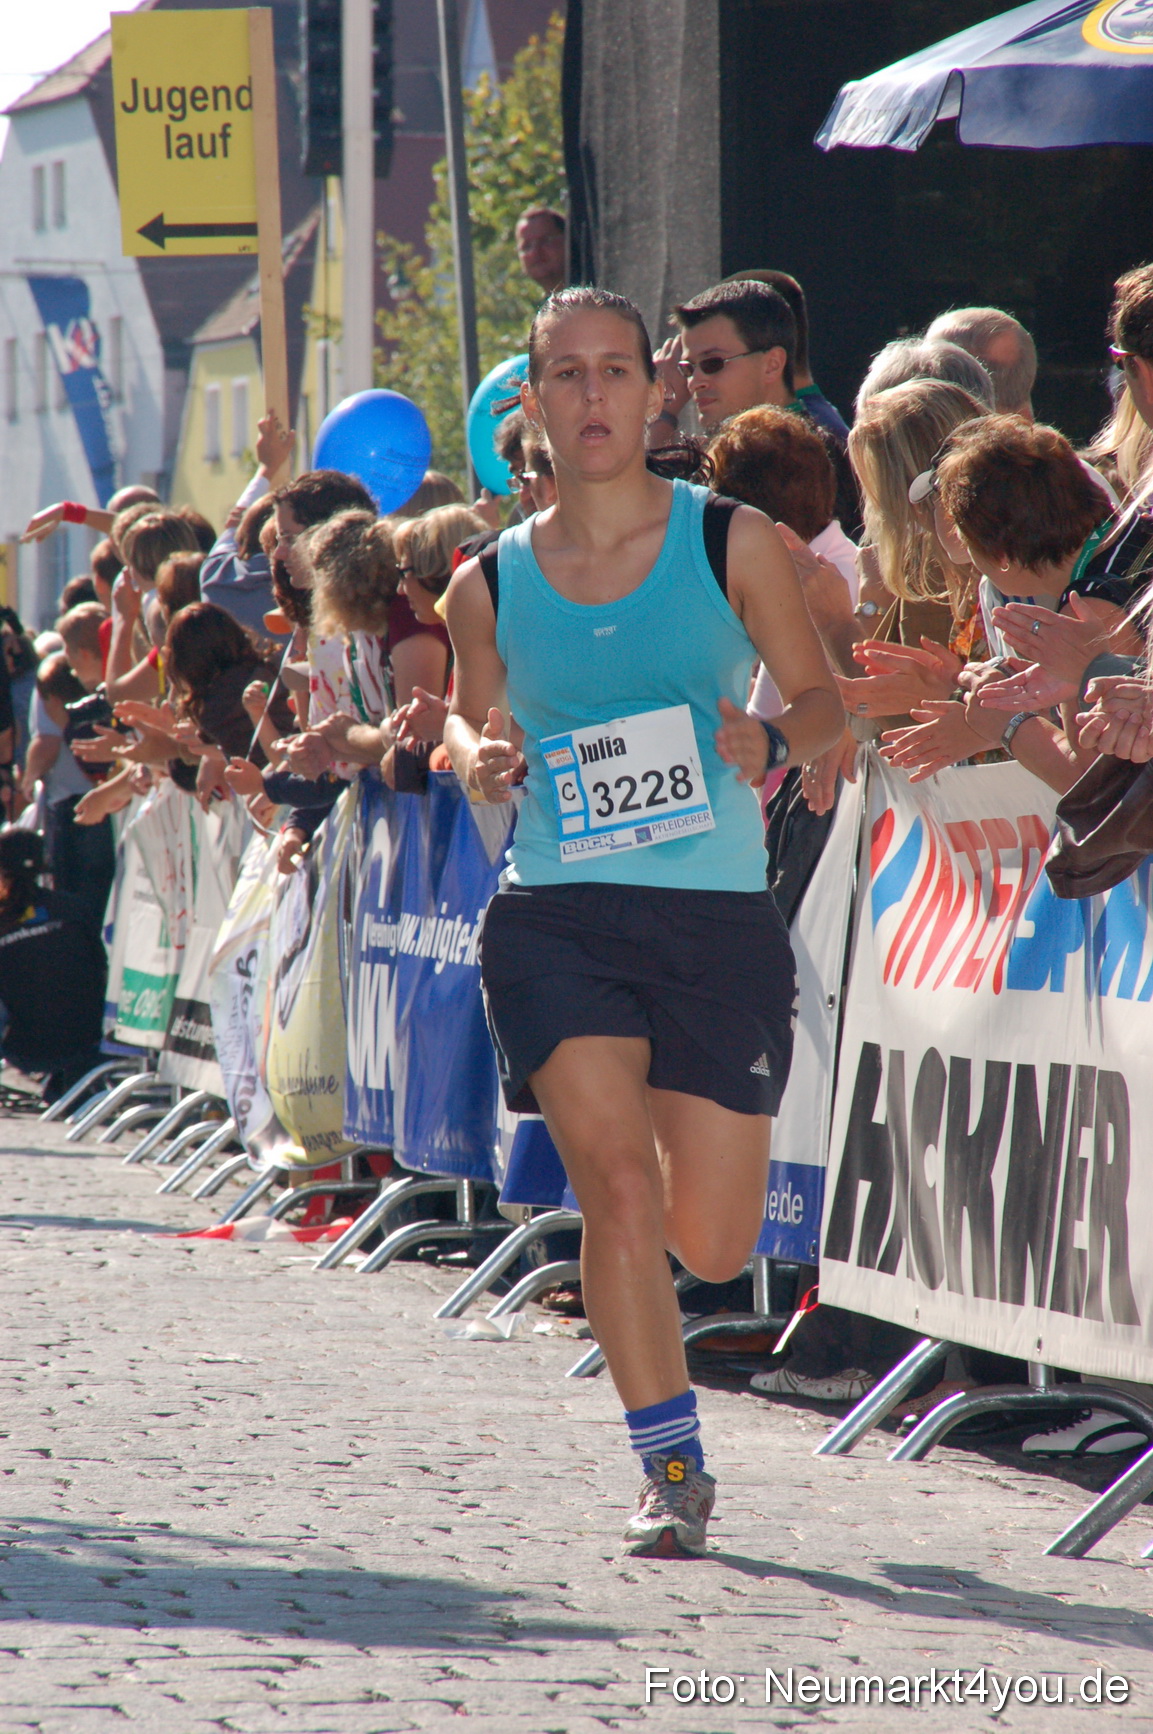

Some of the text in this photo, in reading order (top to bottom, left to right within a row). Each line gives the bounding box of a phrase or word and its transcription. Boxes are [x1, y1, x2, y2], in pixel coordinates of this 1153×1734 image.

[121, 76, 252, 122] Jugend
[165, 122, 232, 160] lauf
[579, 736, 627, 765] Julia
[562, 782, 576, 801] C
[592, 764, 693, 818] 3228
[652, 811, 711, 834] PFLEIDERER
[823, 1041, 1141, 1326] HACKNER
[764, 1182, 804, 1224] e.de
[667, 1461, 685, 1482] S
